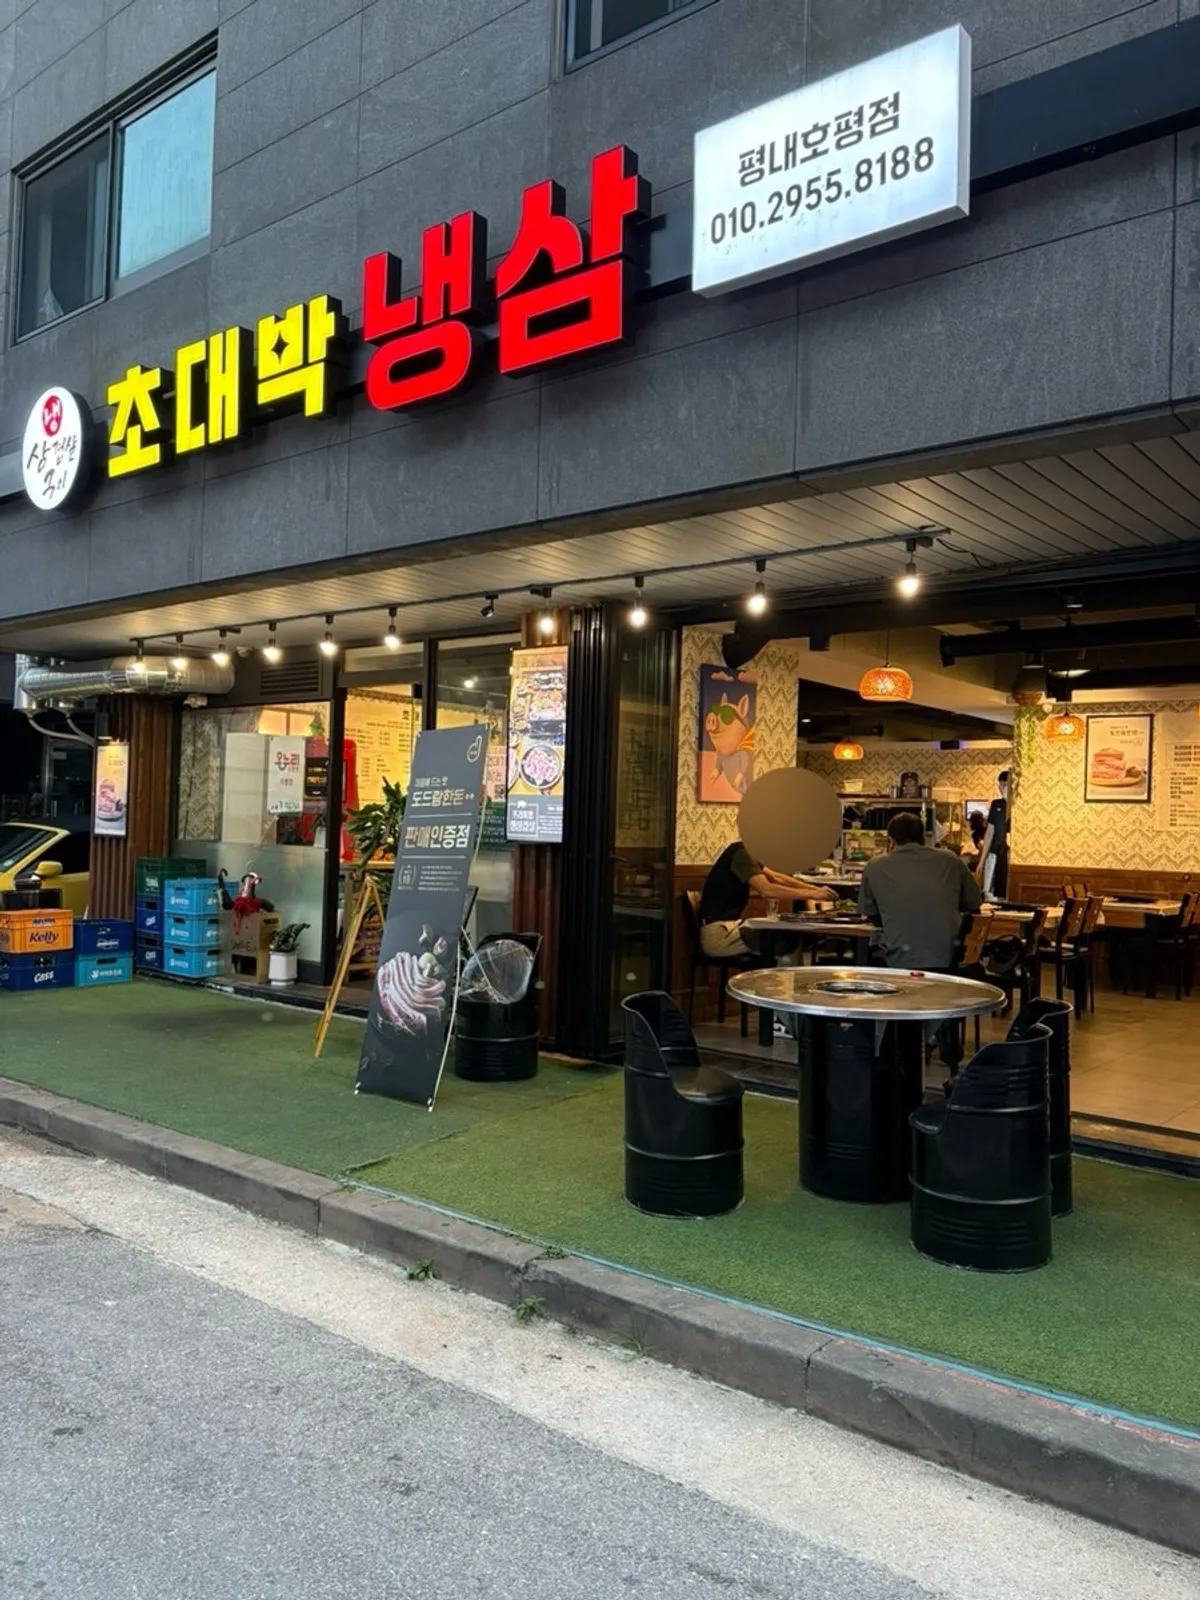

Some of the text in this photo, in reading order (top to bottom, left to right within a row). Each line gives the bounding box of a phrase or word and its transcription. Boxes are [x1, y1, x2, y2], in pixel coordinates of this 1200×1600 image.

[738, 91, 900, 188] 평내호평점
[710, 136, 935, 245] 010.2955.8188
[107, 145, 638, 479] 초대박 냉삼
[411, 788, 465, 807] 도드람한돈
[404, 825, 470, 849] 판매인증점
[29, 931, 59, 944] Kelly
[34, 970, 55, 984] Cass
